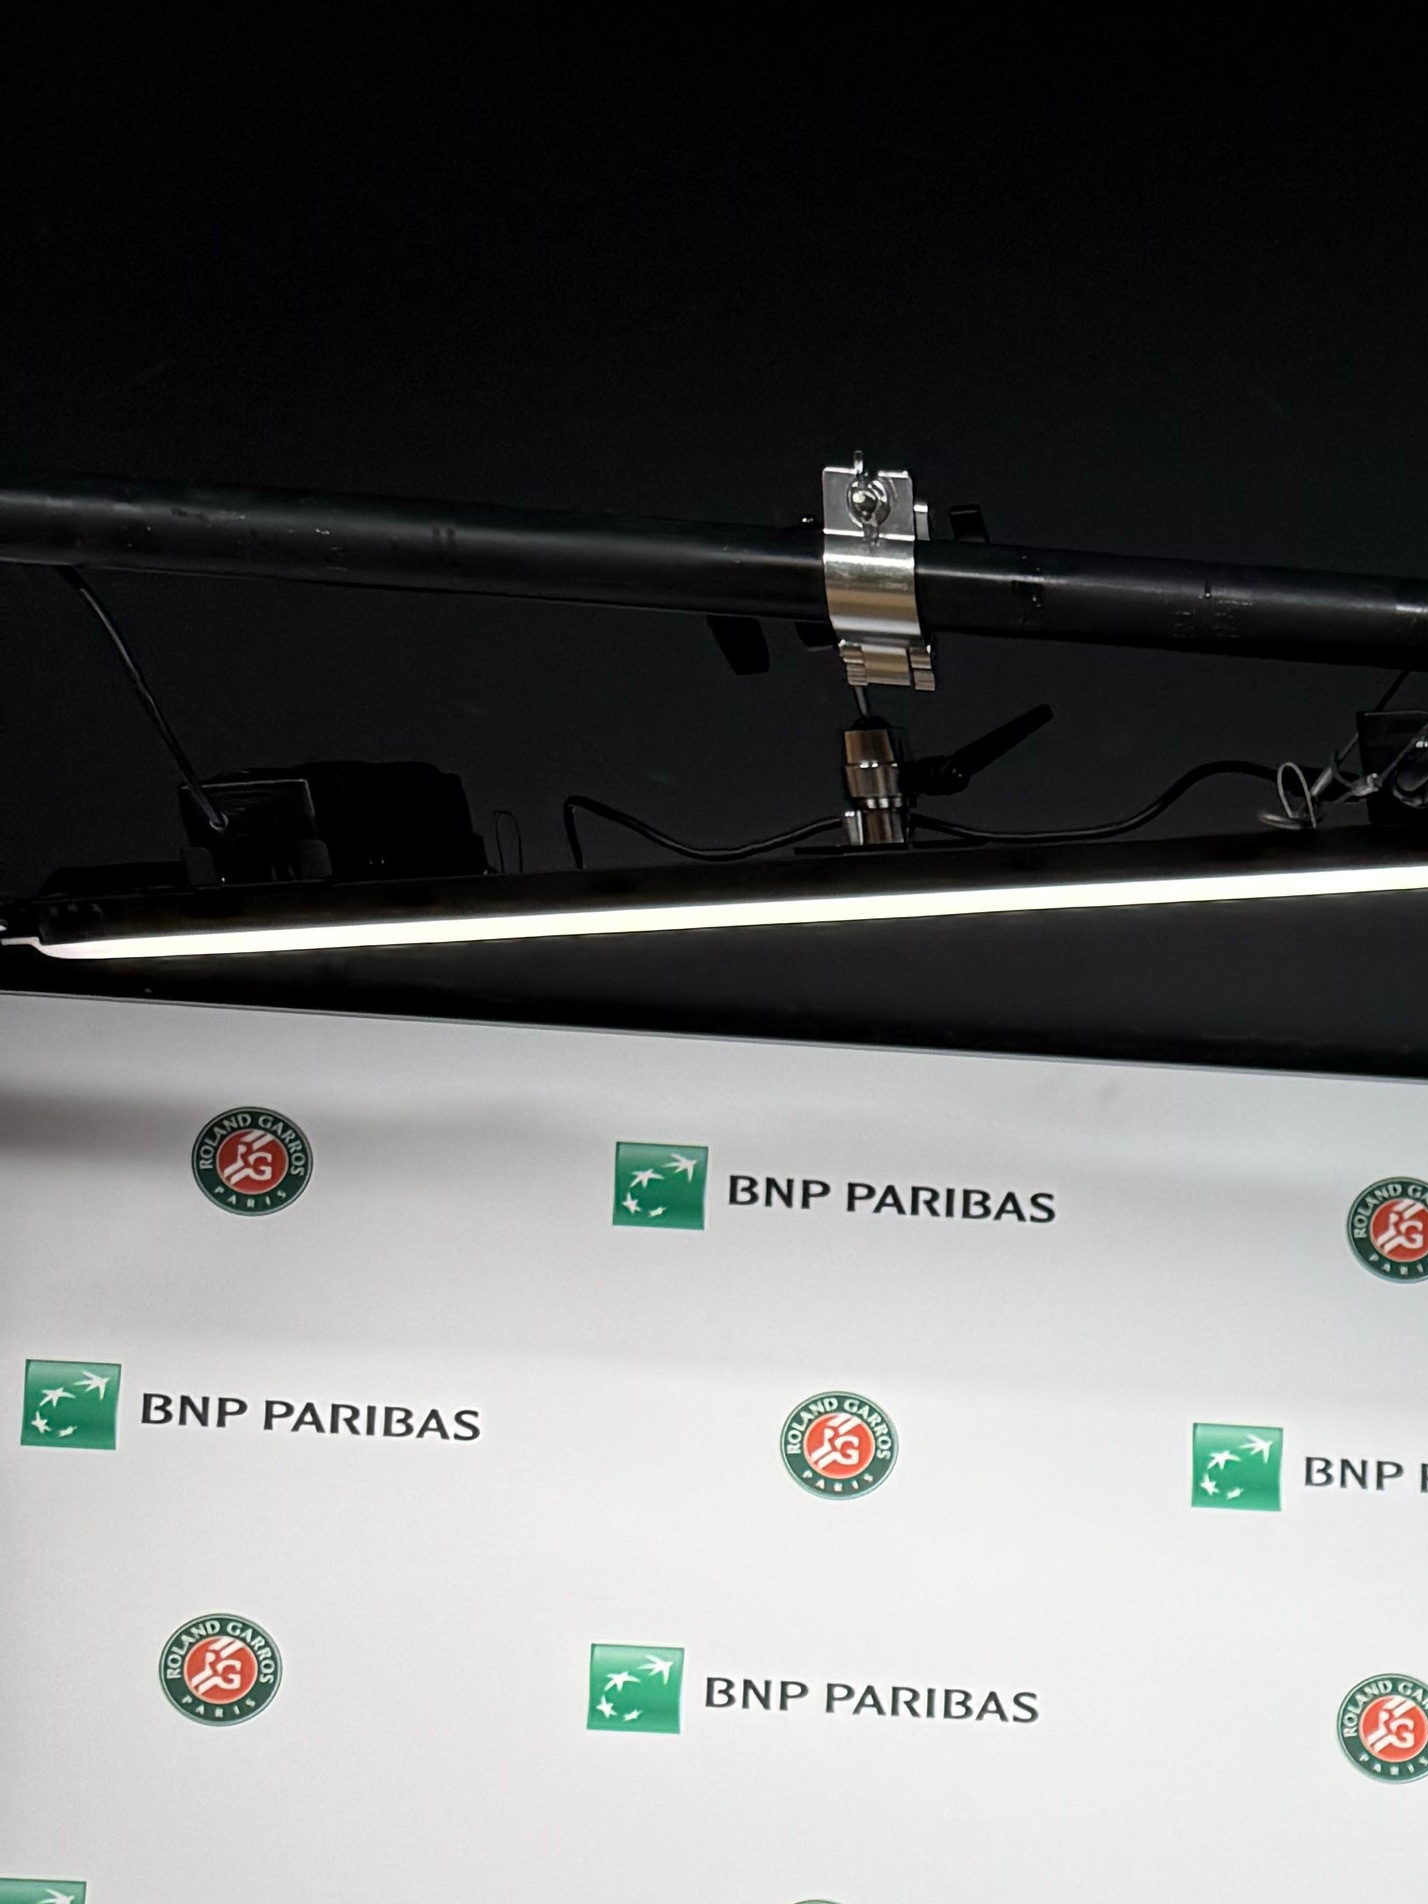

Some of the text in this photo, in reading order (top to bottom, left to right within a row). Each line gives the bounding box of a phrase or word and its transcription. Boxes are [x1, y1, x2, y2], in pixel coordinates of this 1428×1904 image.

[198, 1113, 306, 1176] ROLAND GARROS
[728, 1174, 1056, 1224] BNP PARIBAS
[1352, 1182, 1402, 1239] ROLAND
[141, 1392, 480, 1441] BNP PARIBAS
[786, 1397, 892, 1459] ROLAND GARROS
[1305, 1456, 1404, 1490] BNP
[165, 1620, 276, 1684] ROLAND GARROS
[705, 1677, 1039, 1723] BNP PARIBAS
[1342, 1679, 1392, 1738] ROLAND
